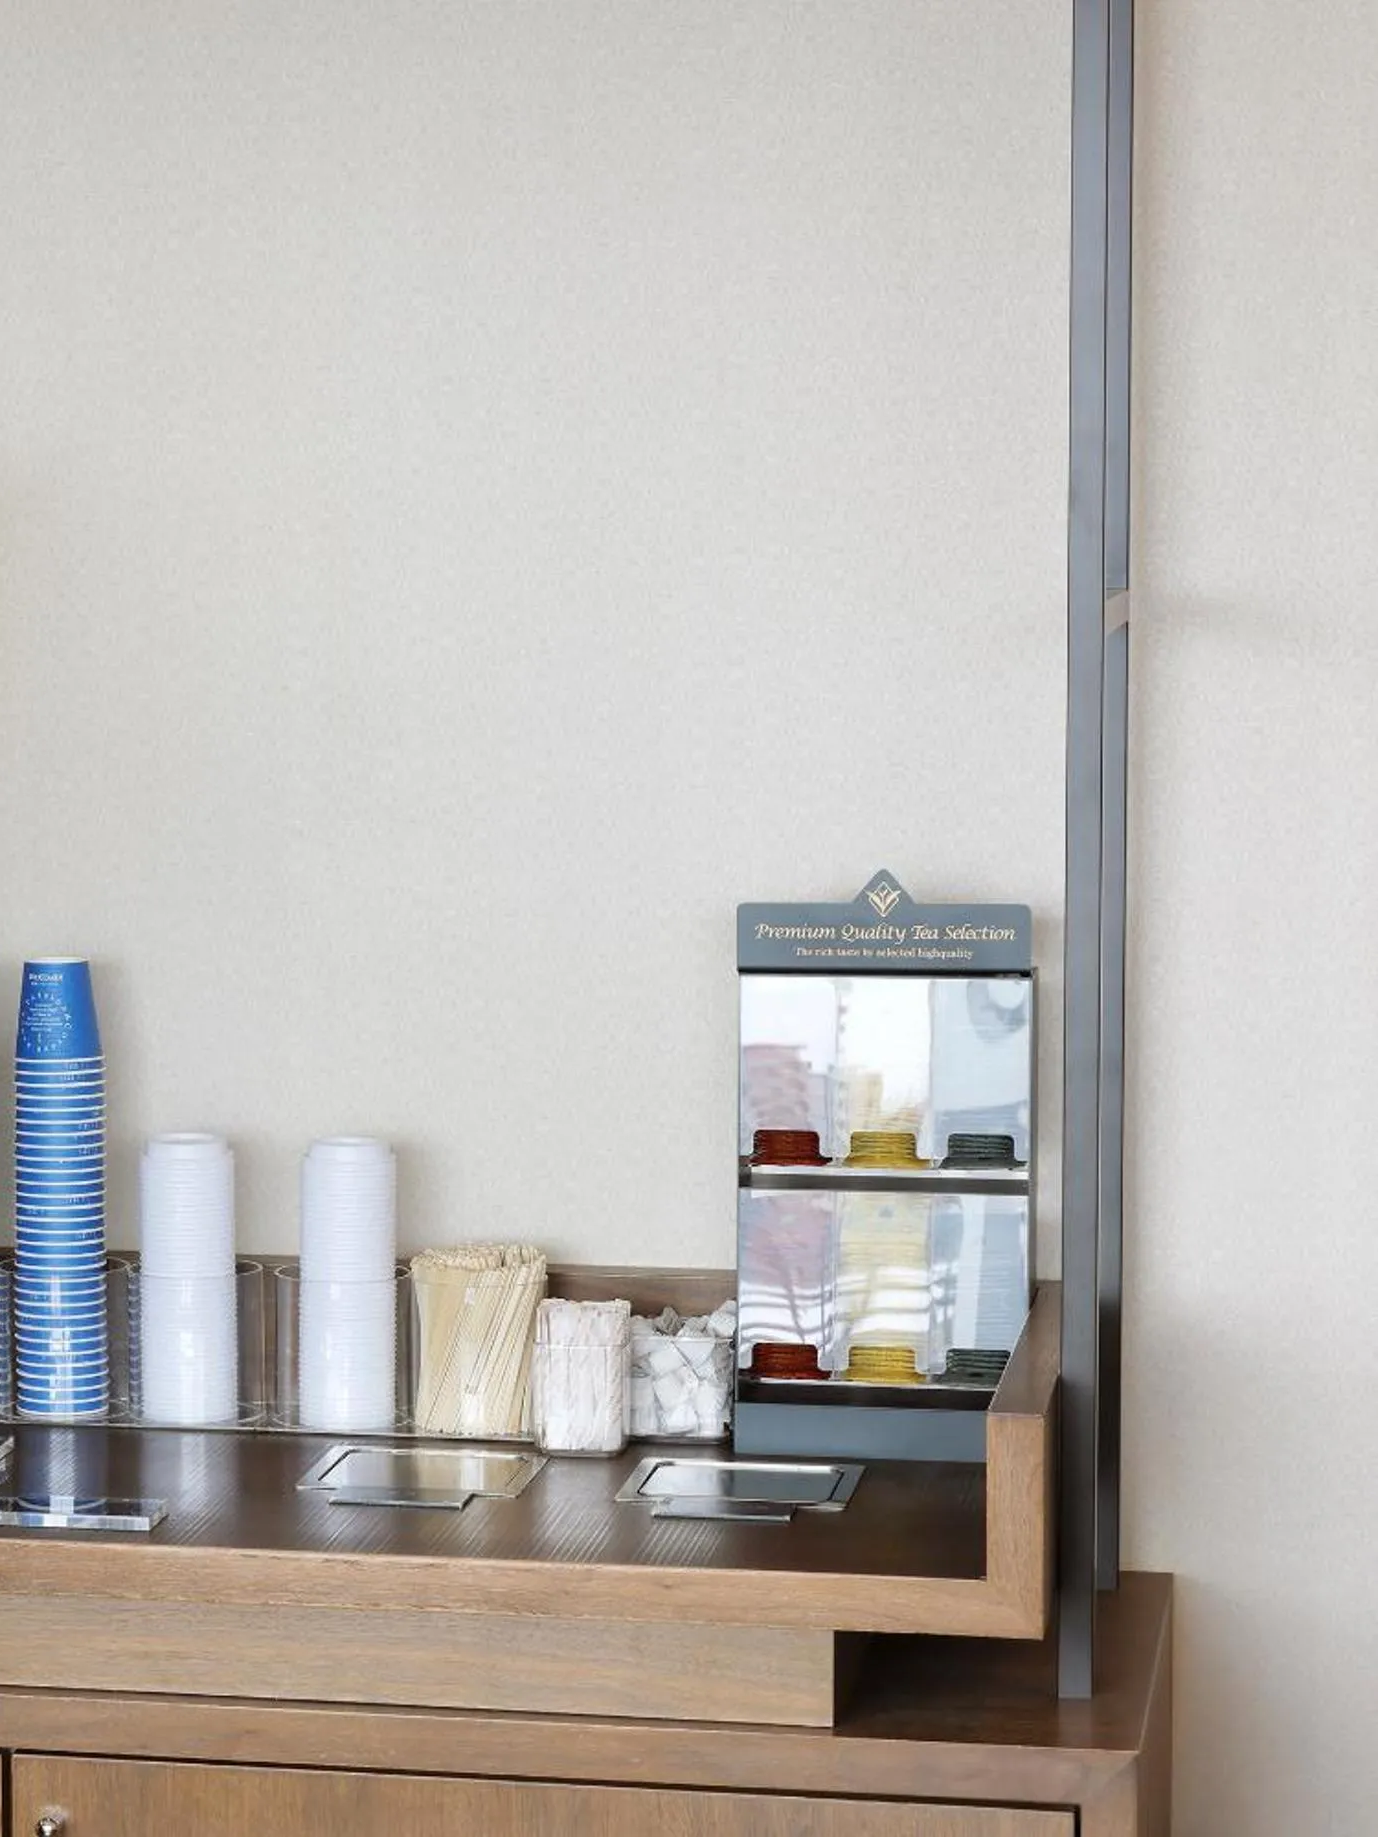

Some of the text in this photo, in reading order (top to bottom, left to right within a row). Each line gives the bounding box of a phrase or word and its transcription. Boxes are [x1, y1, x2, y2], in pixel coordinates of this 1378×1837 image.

[754, 921, 1016, 945] Premium Quality Tea Selection
